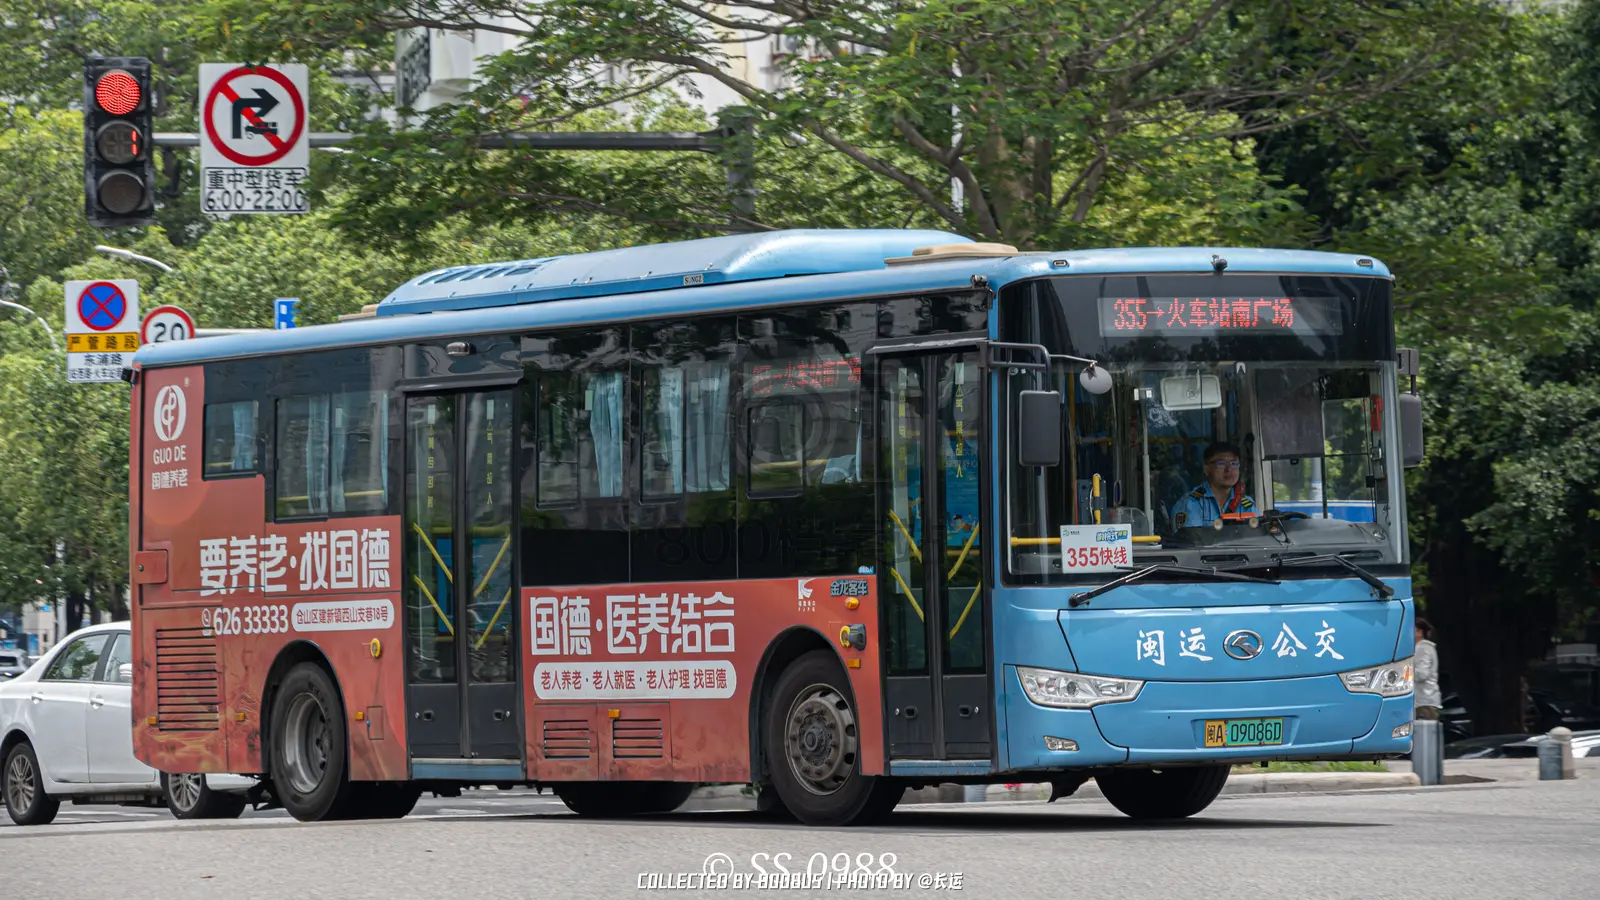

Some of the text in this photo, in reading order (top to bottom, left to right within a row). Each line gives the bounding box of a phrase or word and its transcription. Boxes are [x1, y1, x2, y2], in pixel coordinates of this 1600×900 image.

[207, 168, 302, 189] 重中型货车
[153, 322, 185, 343] 20
[153, 445, 187, 465] GUO DE
[1067, 546, 1128, 567] 355快线
[830, 580, 868, 597] 金龙客车
[530, 591, 735, 656] 国德·医养结合
[1137, 620, 1344, 666] 闽运 公交
